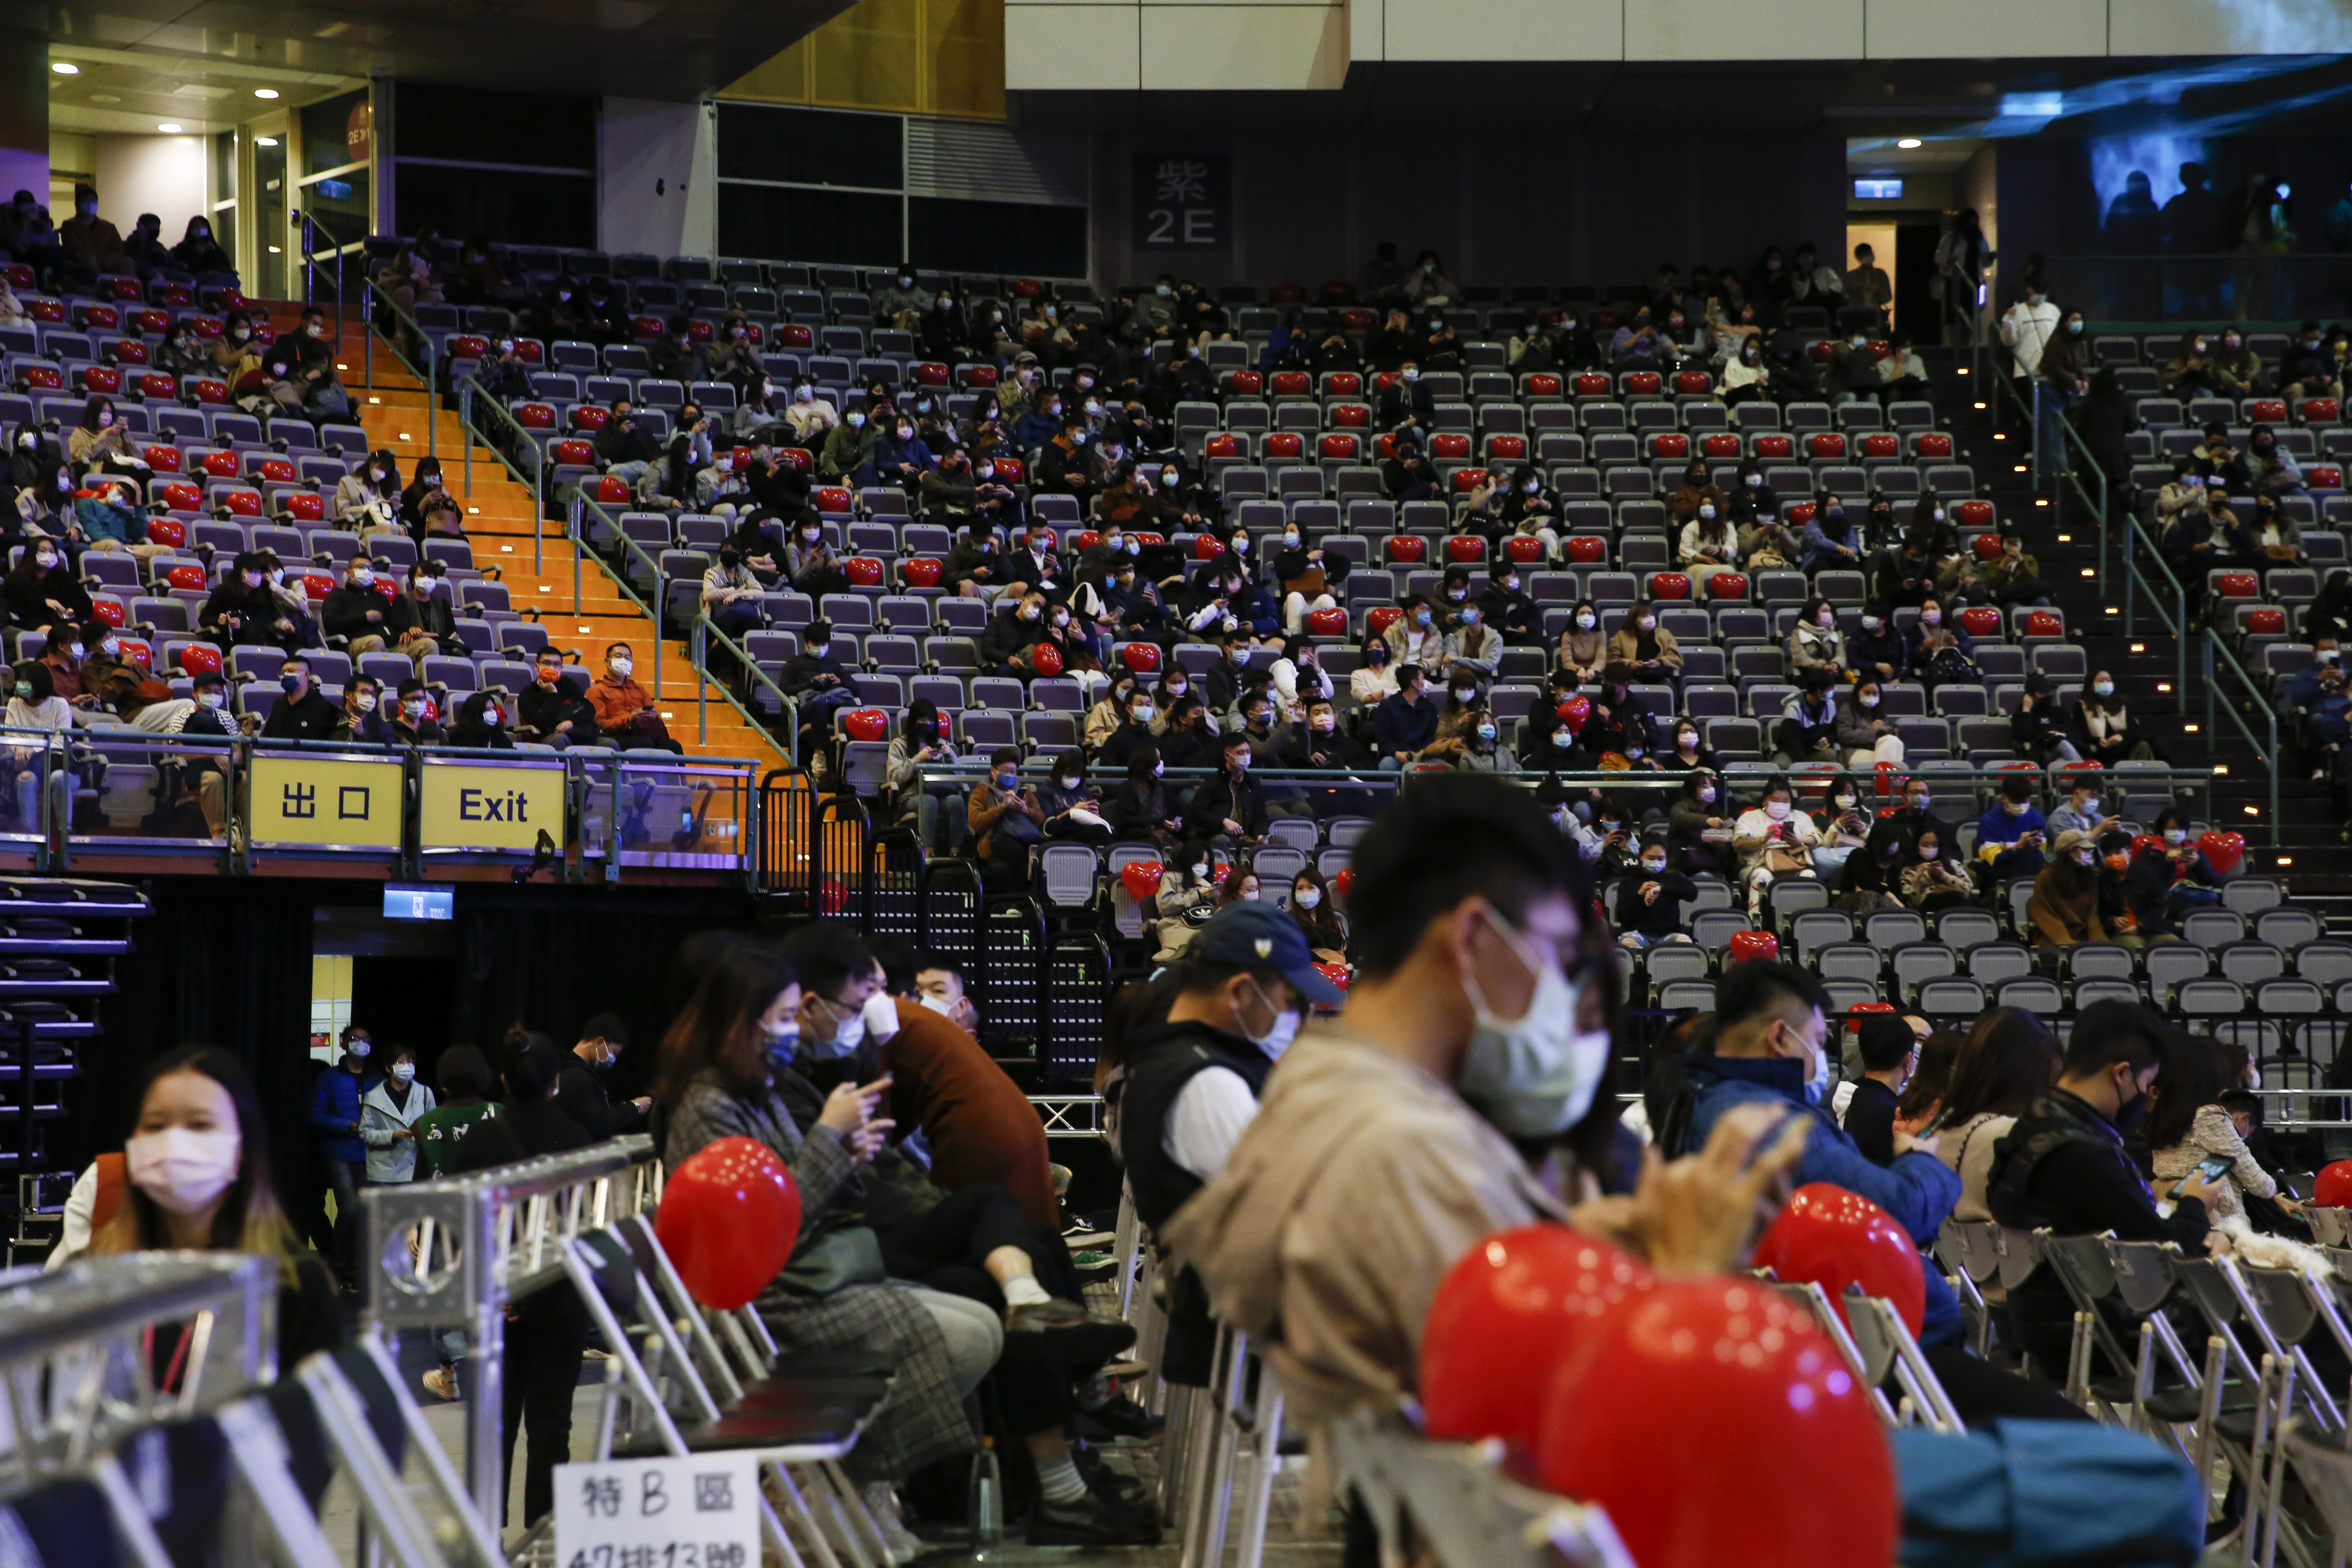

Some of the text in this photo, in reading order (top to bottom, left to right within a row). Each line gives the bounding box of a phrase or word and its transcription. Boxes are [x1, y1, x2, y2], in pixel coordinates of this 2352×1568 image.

[1156, 160, 1207, 201] 紫
[1147, 209, 1215, 243] 2E
[282, 782, 369, 820] 出口
[460, 788, 528, 822] Exit
